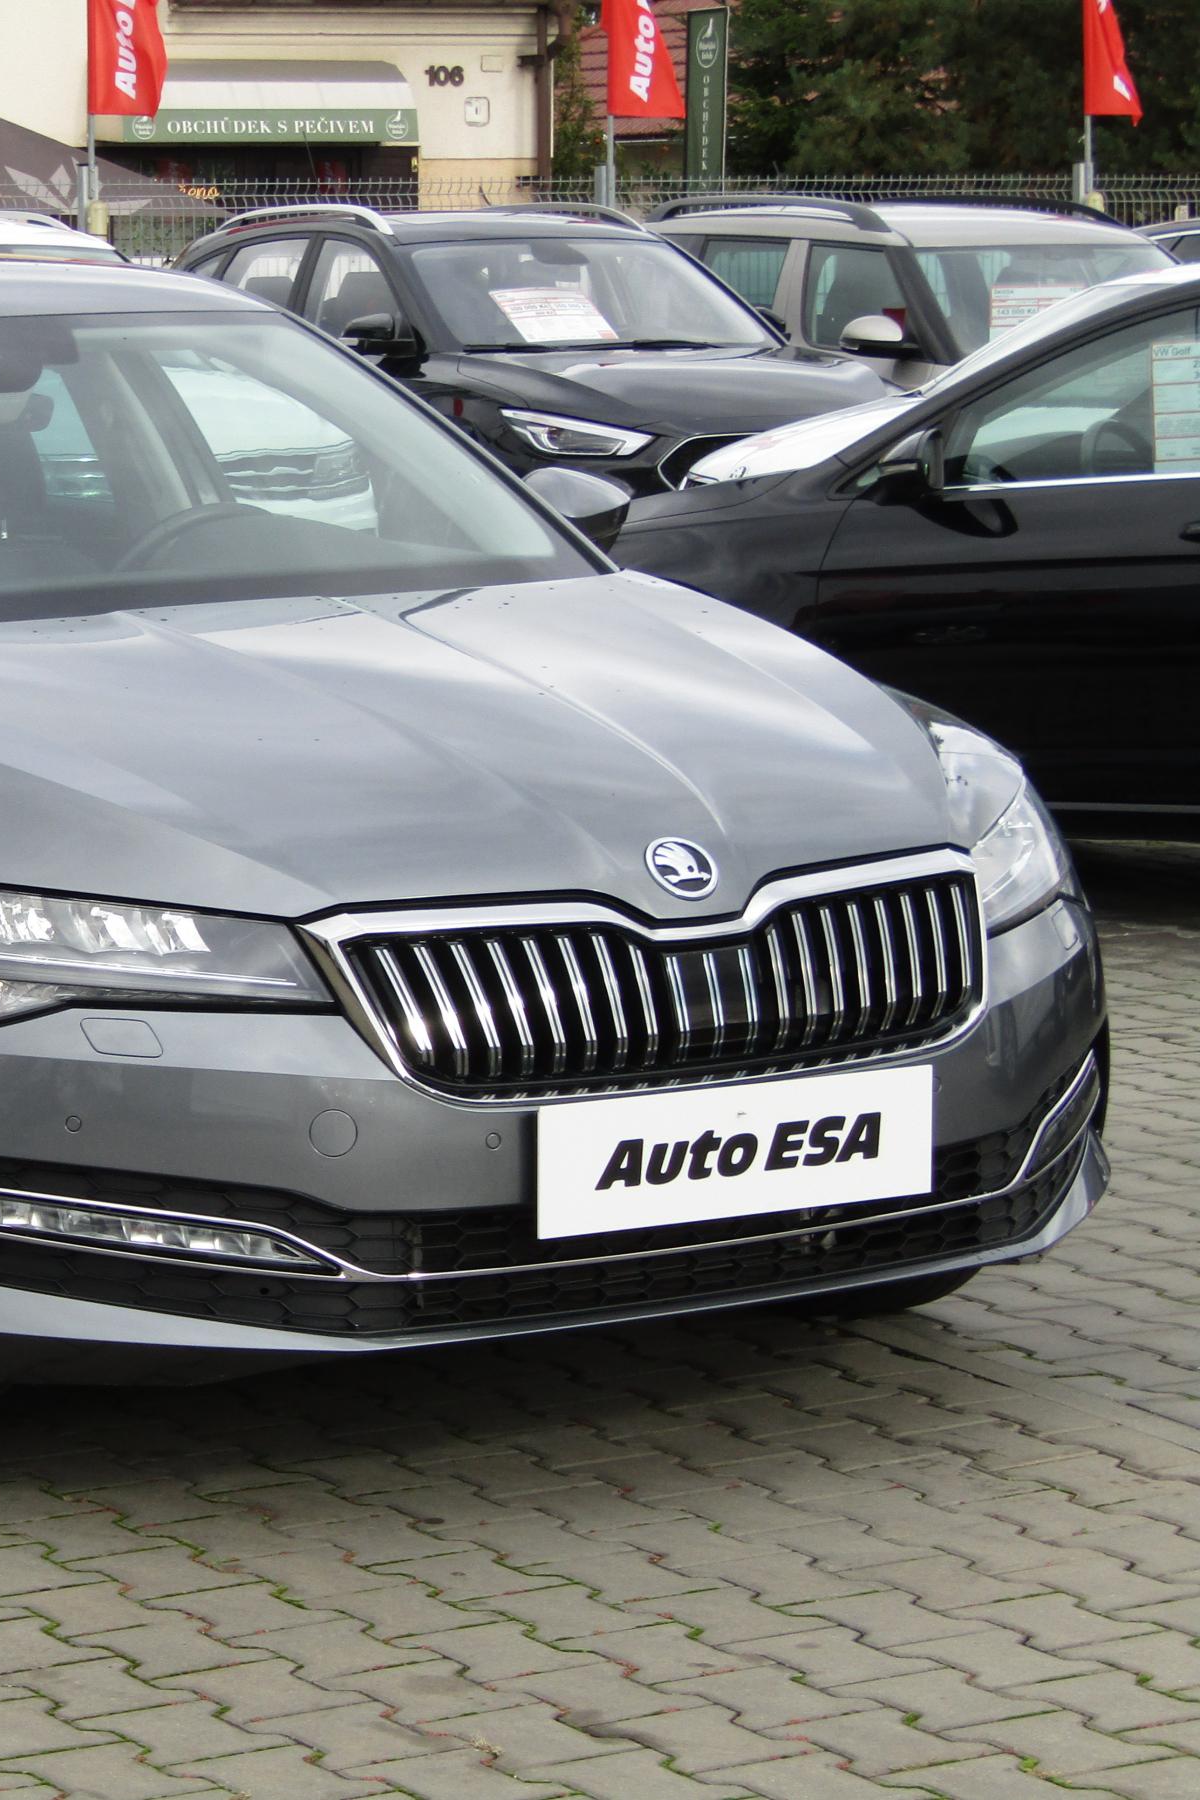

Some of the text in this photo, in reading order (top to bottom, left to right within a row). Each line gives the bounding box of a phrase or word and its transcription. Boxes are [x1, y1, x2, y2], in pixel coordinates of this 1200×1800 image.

[114, 10, 137, 100] Auto
[424, 65, 464, 87] 106
[629, 14, 655, 103] Auto
[167, 116, 272, 134] OBCHŮDEK
[277, 120, 288, 134] S
[294, 117, 375, 134] PEČIVEM
[595, 1112, 881, 1190] Auto ESA
